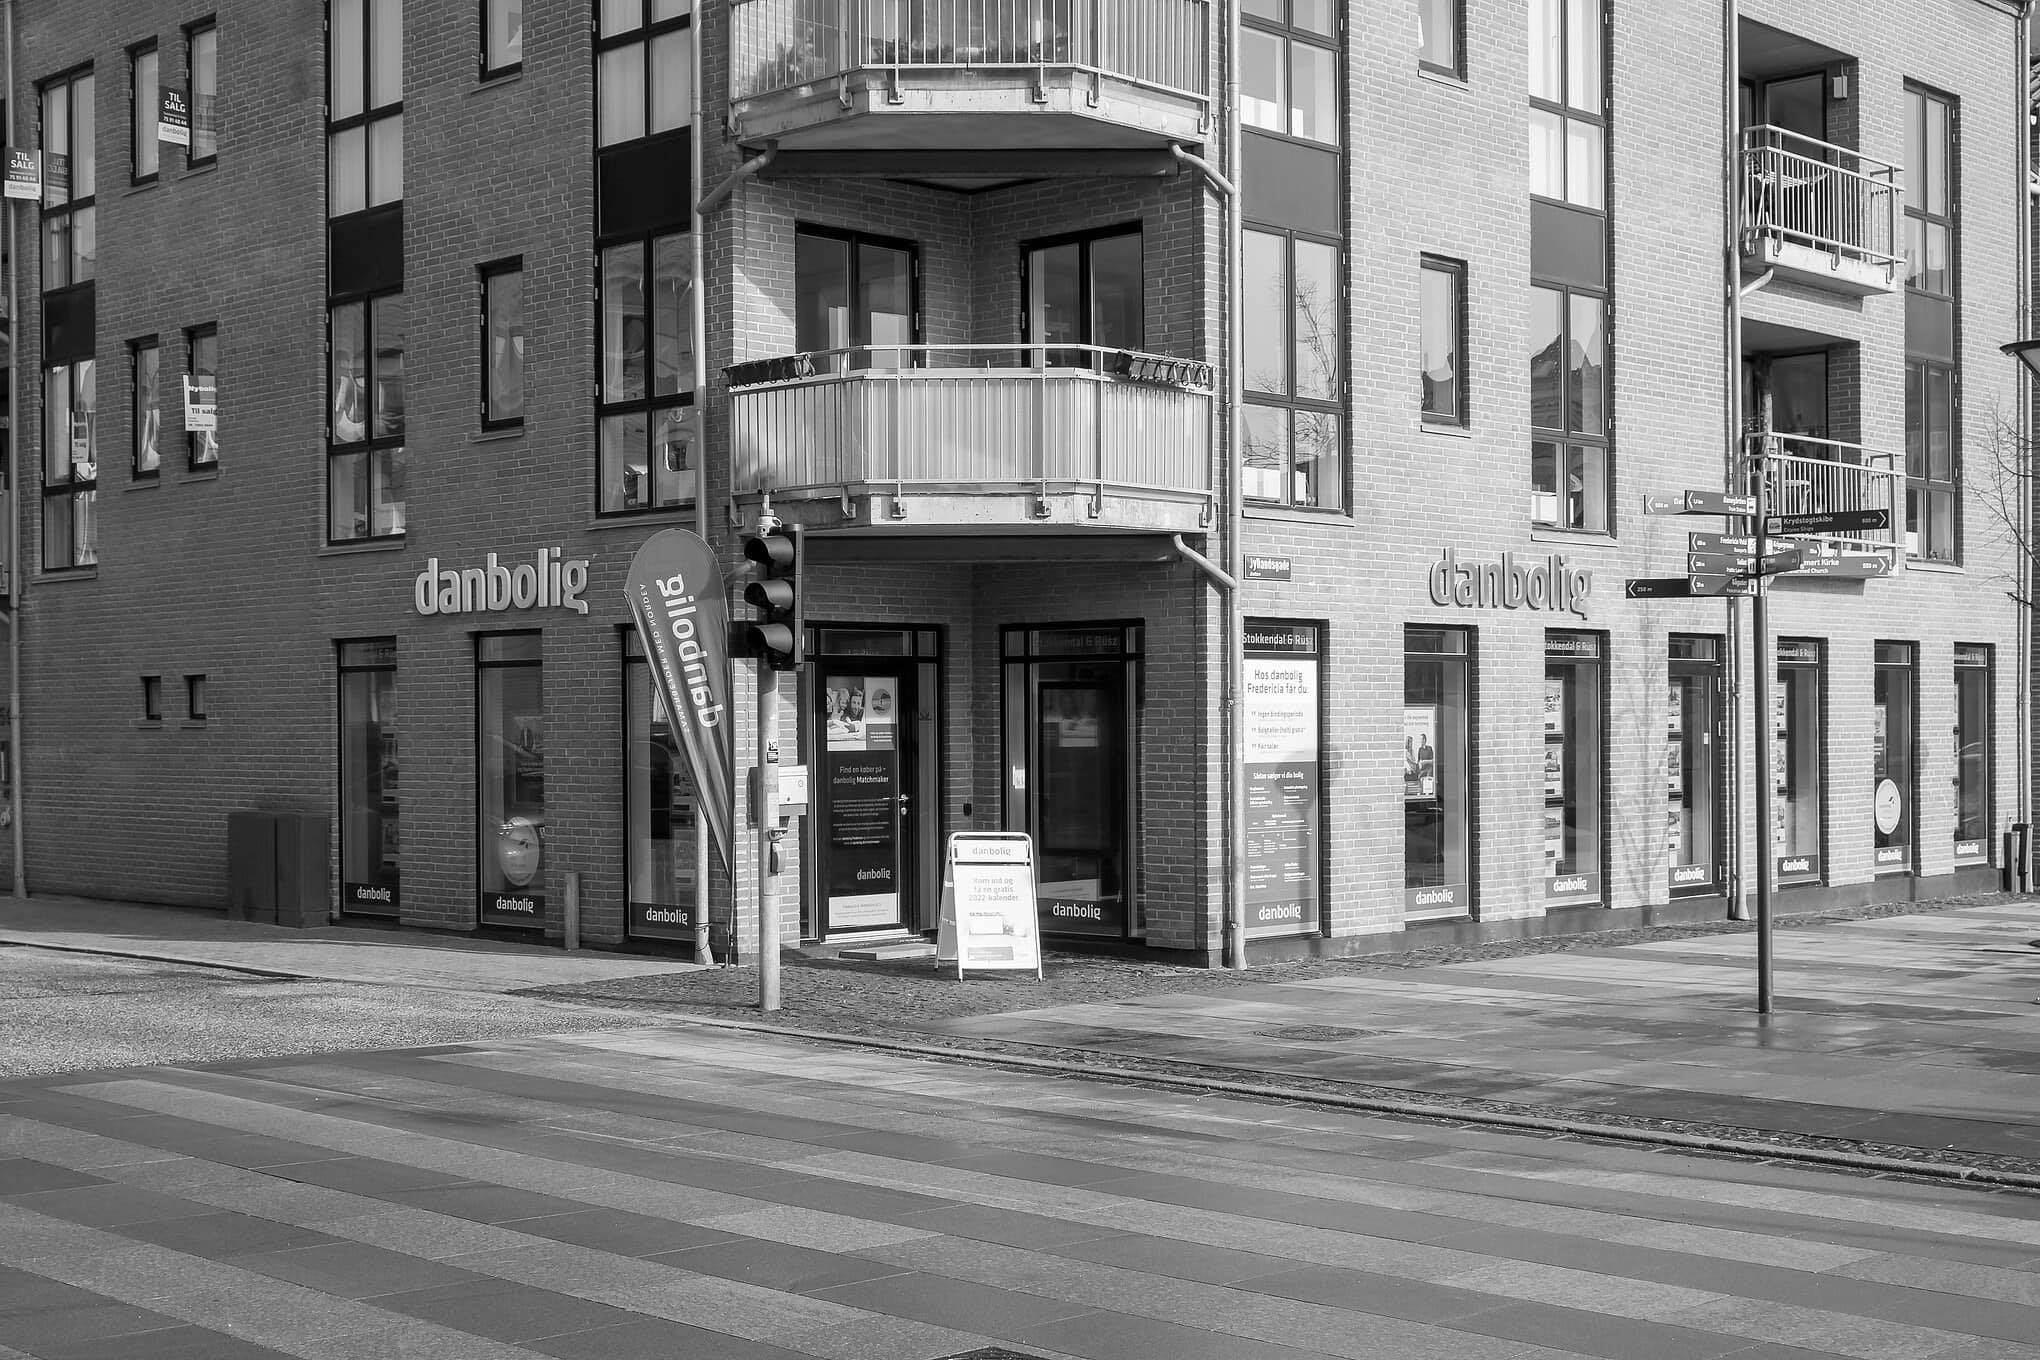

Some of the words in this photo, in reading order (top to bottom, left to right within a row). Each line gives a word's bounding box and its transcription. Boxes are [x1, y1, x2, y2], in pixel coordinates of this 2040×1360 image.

[168, 91, 182, 103] TIL
[164, 100, 186, 113] SALG
[15, 151, 30, 161] TIL
[10, 159, 35, 170] SALG
[1249, 557, 1290, 573] Jyllandsgade
[415, 547, 590, 615] danbolig
[1429, 547, 1594, 621] danbolig
[1242, 632, 1286, 646] Stokkendal
[1287, 634, 1293, 645] &
[1254, 669, 1269, 681] Hos
[1270, 669, 1303, 684] danbolig
[1247, 682, 1284, 695] Fredericia
[839, 766, 852, 774] Find
[856, 775, 889, 784] Matchmaker
[972, 847, 1012, 857] danbolig
[1878, 849, 1903, 862] danbolig
[1782, 858, 1810, 872] danbolig
[857, 867, 891, 881] danbolig
[1674, 868, 1705, 882] danbolig
[1553, 876, 1588, 892] danbolig
[357, 886, 391, 902] danbolig
[1415, 889, 1454, 905] danbolig
[495, 896, 535, 914] danbolig
[1052, 902, 1101, 921] danbolig
[1258, 903, 1302, 921] danbolig
[645, 907, 689, 926] danbolig
